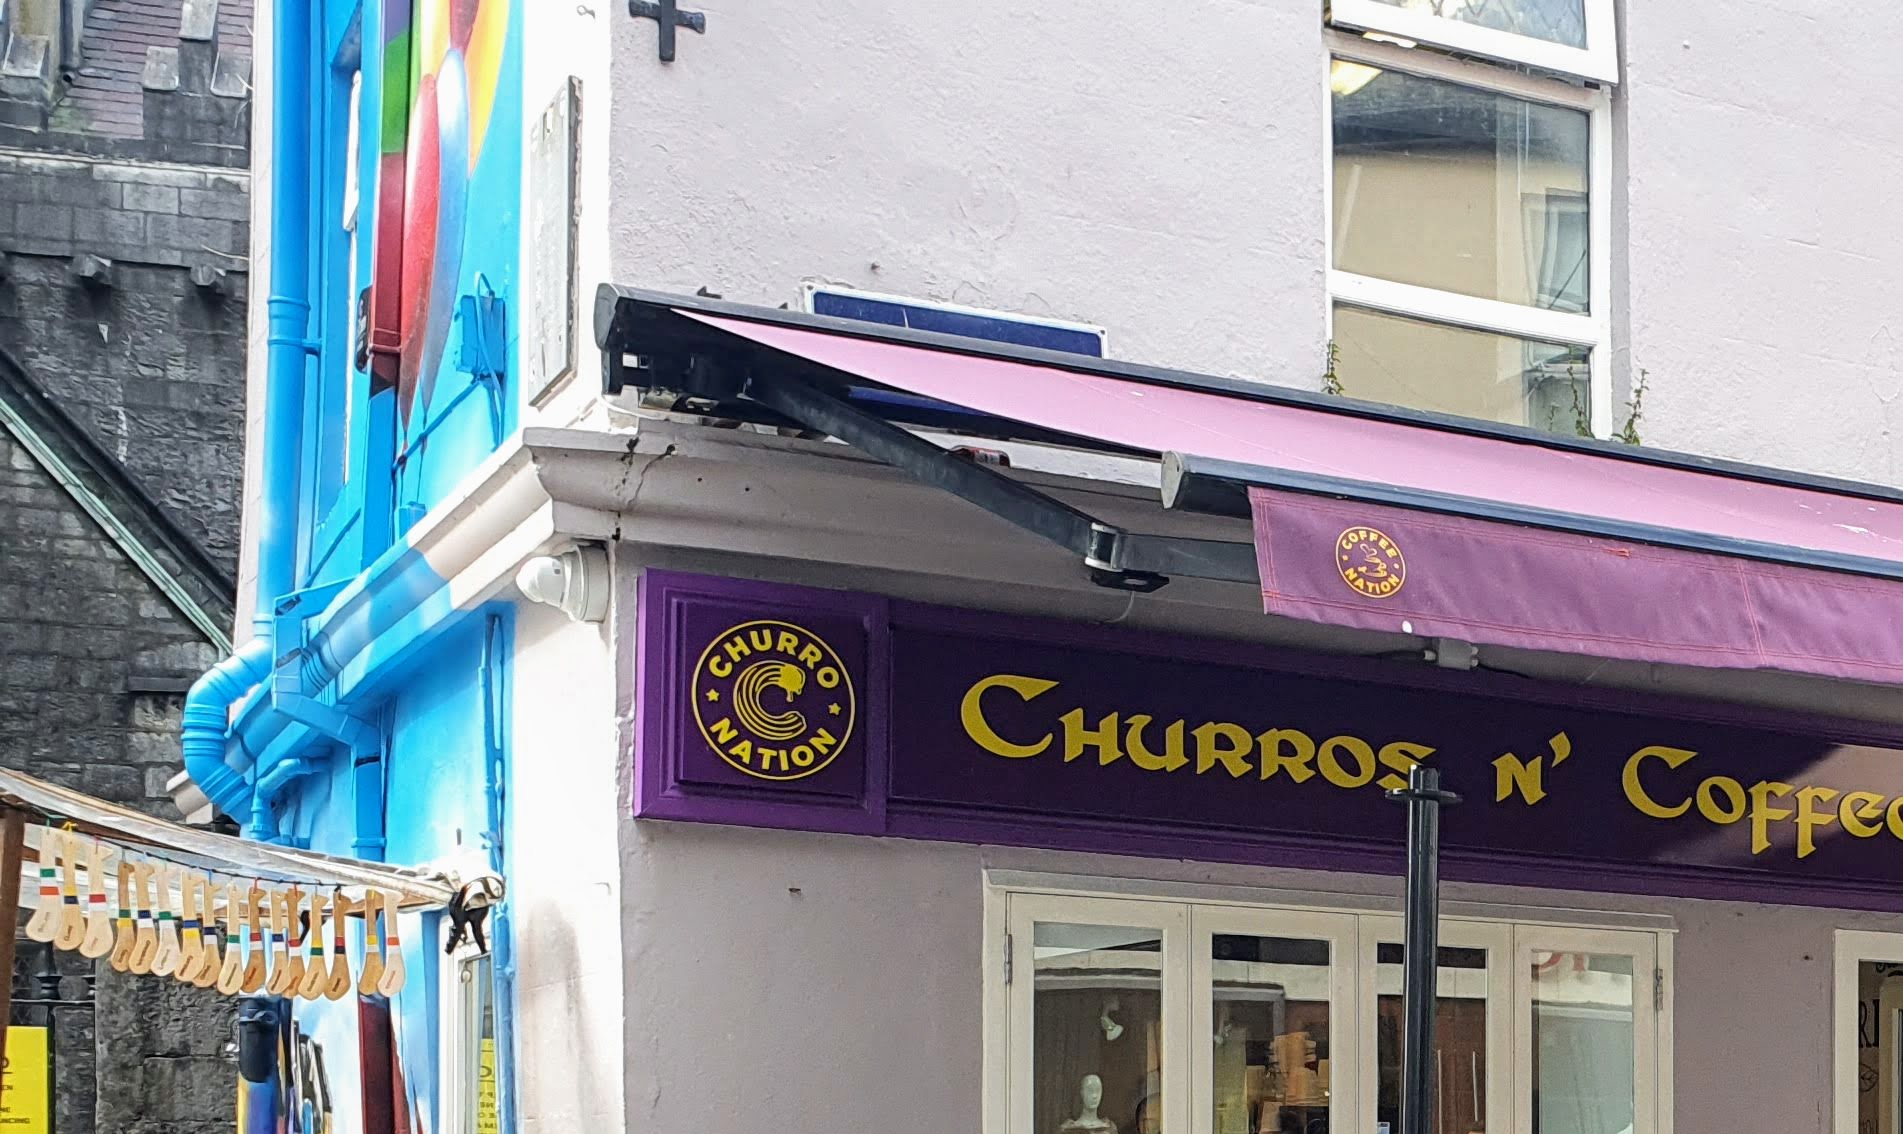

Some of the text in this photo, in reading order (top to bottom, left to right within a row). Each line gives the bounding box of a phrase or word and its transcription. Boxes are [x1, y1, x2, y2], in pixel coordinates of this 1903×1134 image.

[1342, 530, 1398, 558] COFFEE
[1344, 568, 1400, 594] NATION
[707, 627, 840, 690] CHURRO
[710, 716, 838, 772] NATION
